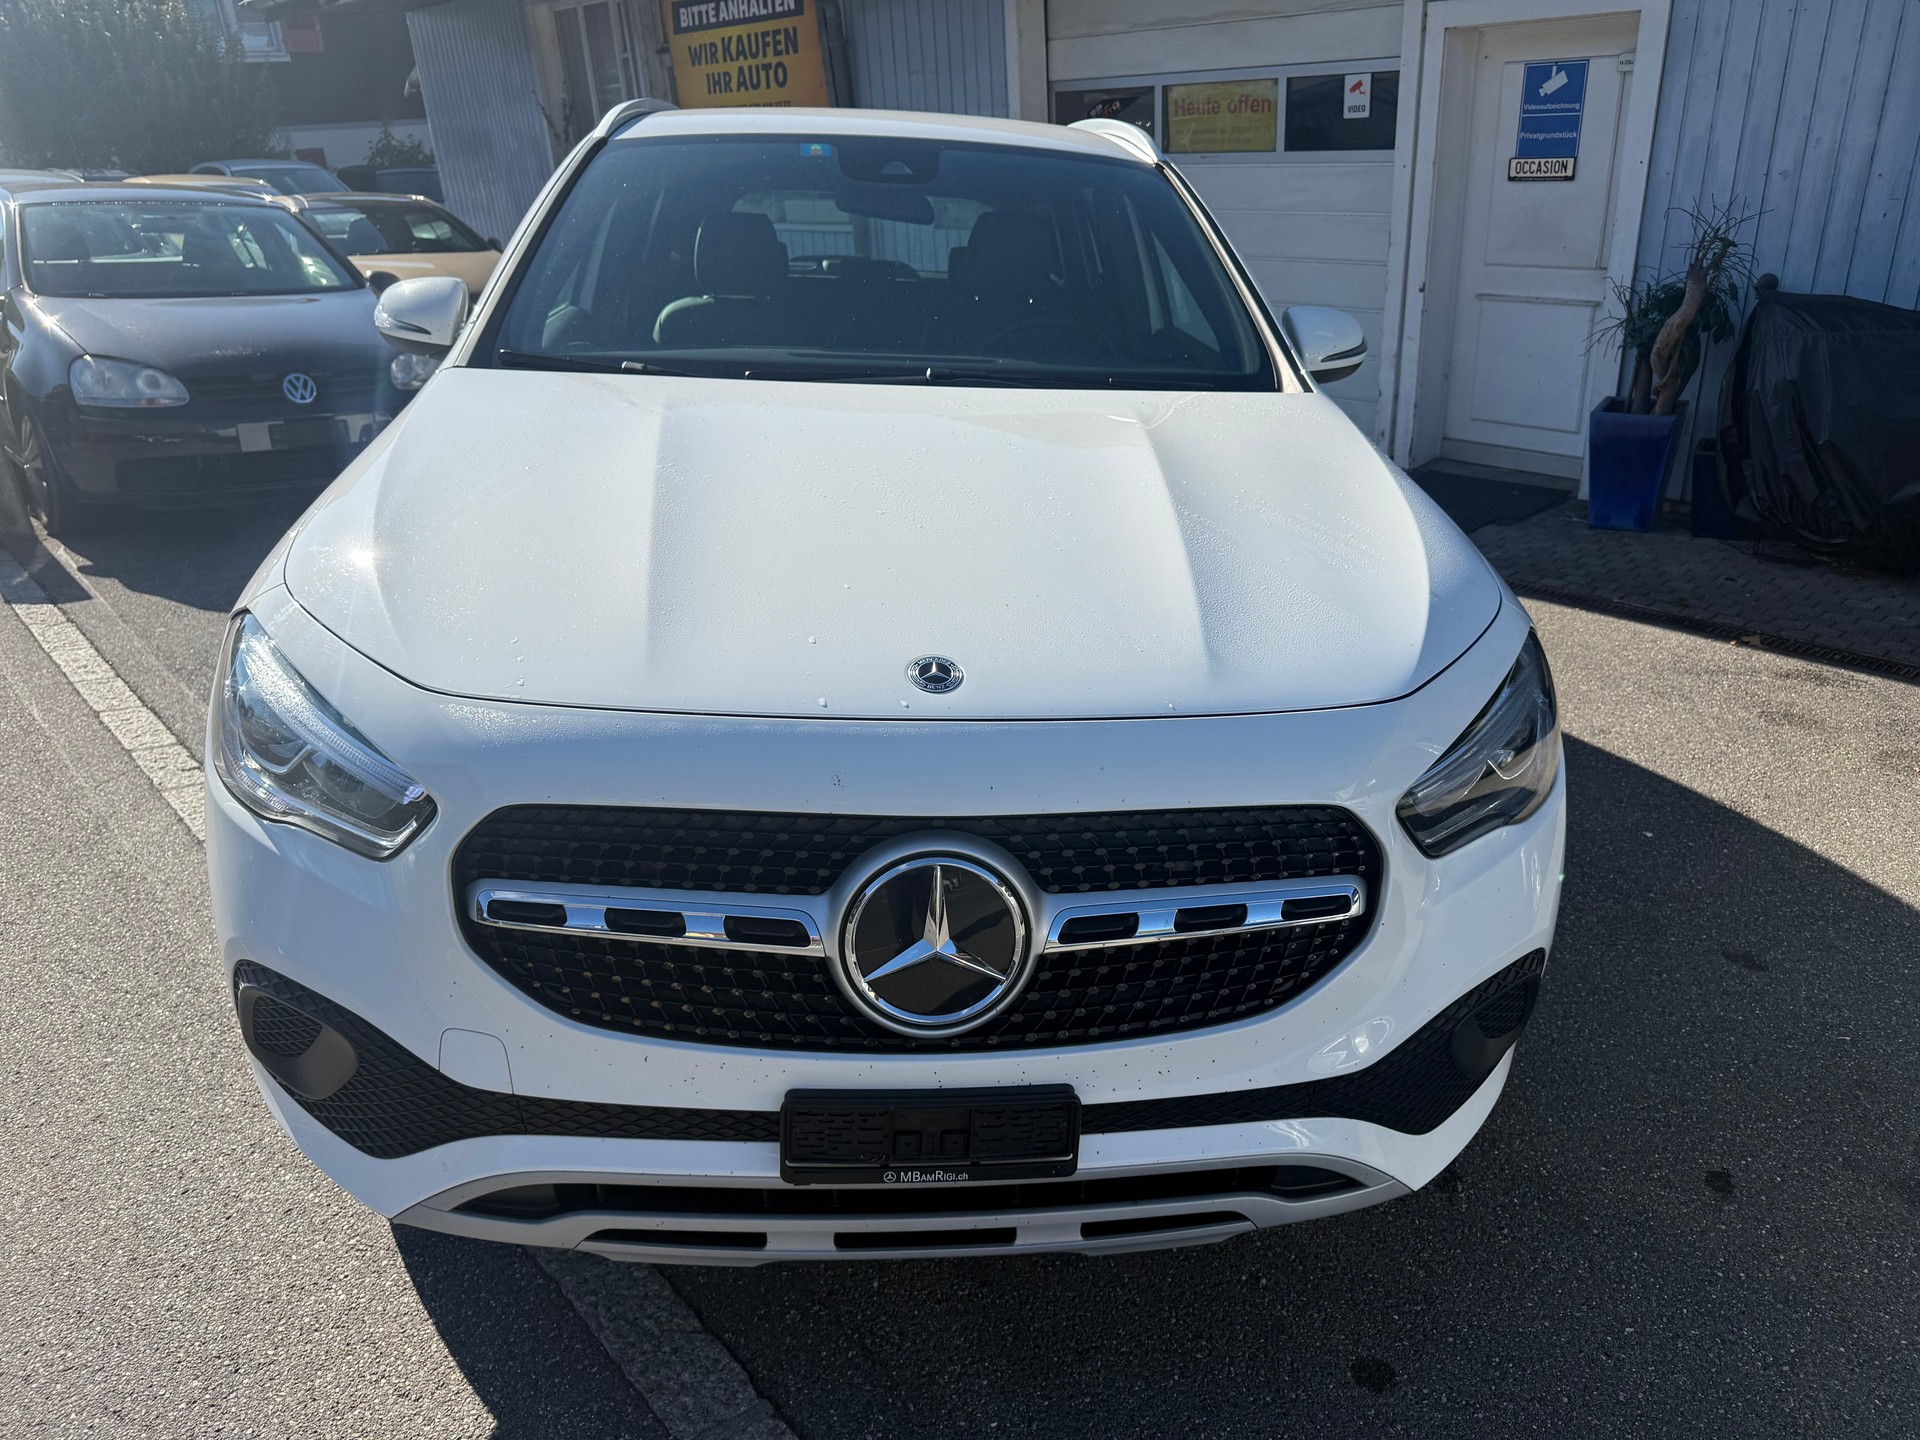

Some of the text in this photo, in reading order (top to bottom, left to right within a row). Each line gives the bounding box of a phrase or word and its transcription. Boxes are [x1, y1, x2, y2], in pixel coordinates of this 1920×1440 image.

[679, 0, 796, 28] BITTE ANHALTEN
[688, 26, 799, 67] WIR KAUFEN
[706, 61, 788, 95] IHR AUTO
[1174, 94, 1272, 116] Heute offen
[1347, 104, 1366, 113] VIDEO
[1523, 102, 1580, 111] Videoaufzeichnung
[1520, 131, 1578, 141] Privatgrundstück
[1515, 160, 1569, 175] OCCASION
